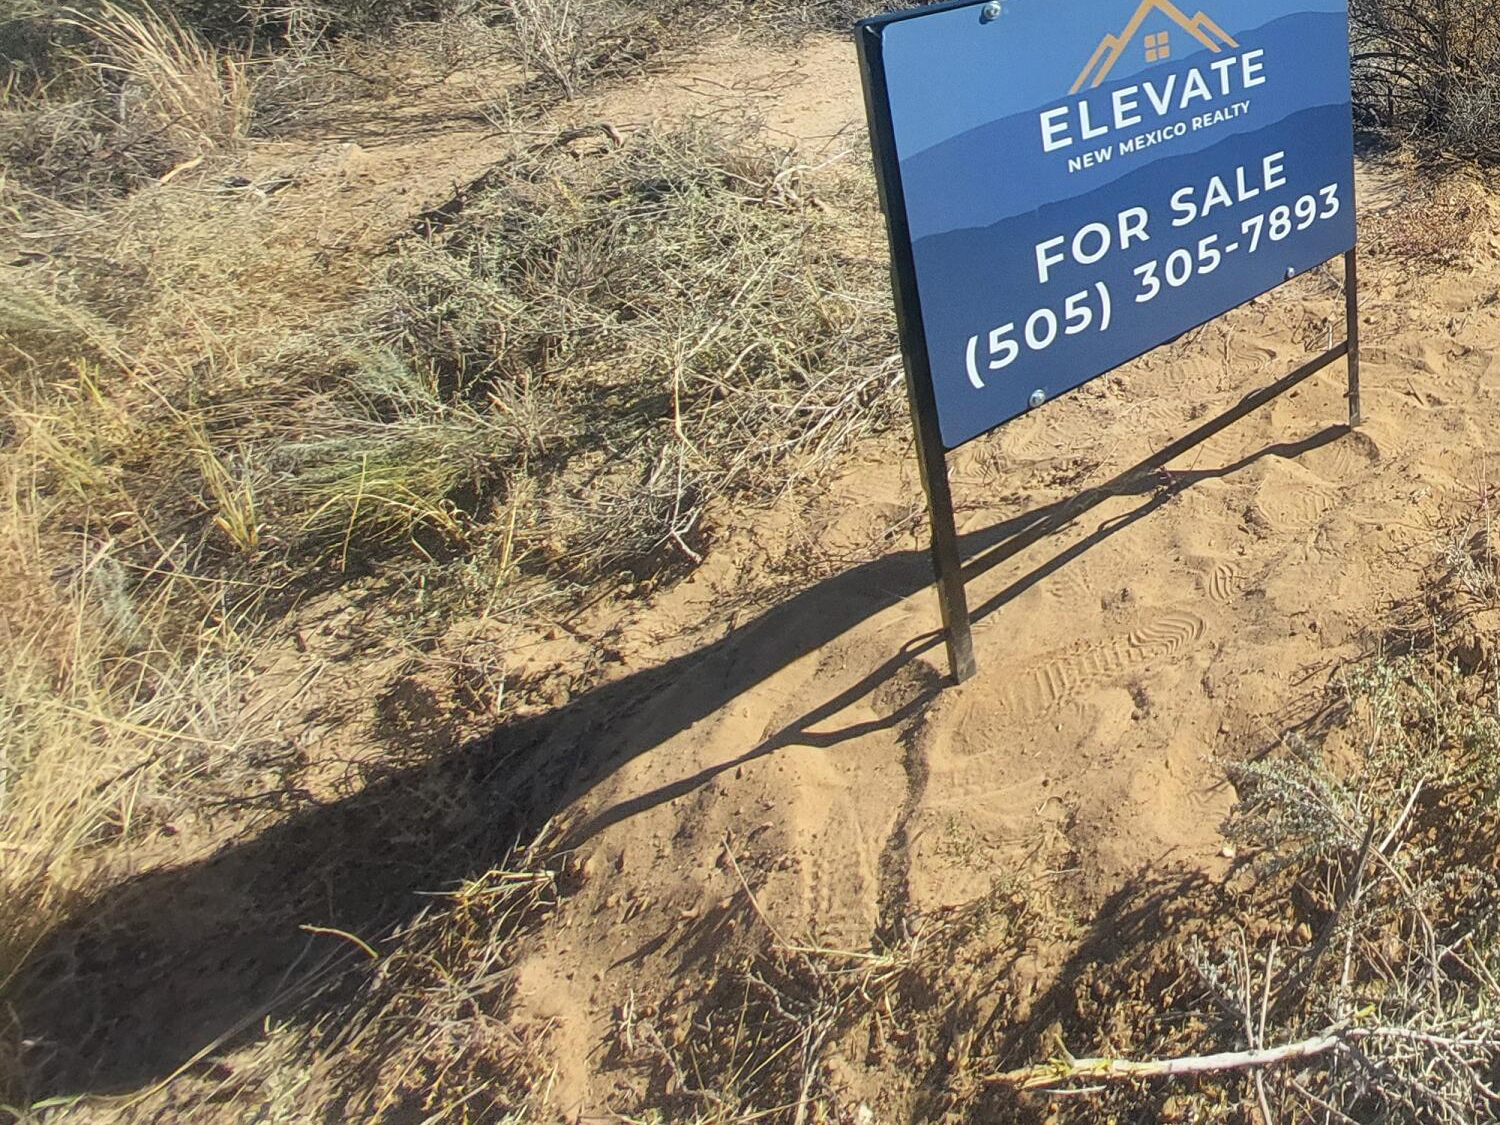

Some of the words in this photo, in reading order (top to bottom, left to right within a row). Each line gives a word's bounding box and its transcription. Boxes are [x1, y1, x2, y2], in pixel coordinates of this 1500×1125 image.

[1040, 49, 1266, 152] ELEVATE
[1067, 146, 1112, 173] NEW
[1119, 121, 1187, 156] MEXICO
[1191, 100, 1251, 131] REALTY
[1034, 205, 1149, 283] FOR
[1170, 151, 1287, 227] SALE
[965, 281, 1111, 389] (505)
[1133, 183, 1341, 304] 305-7893
